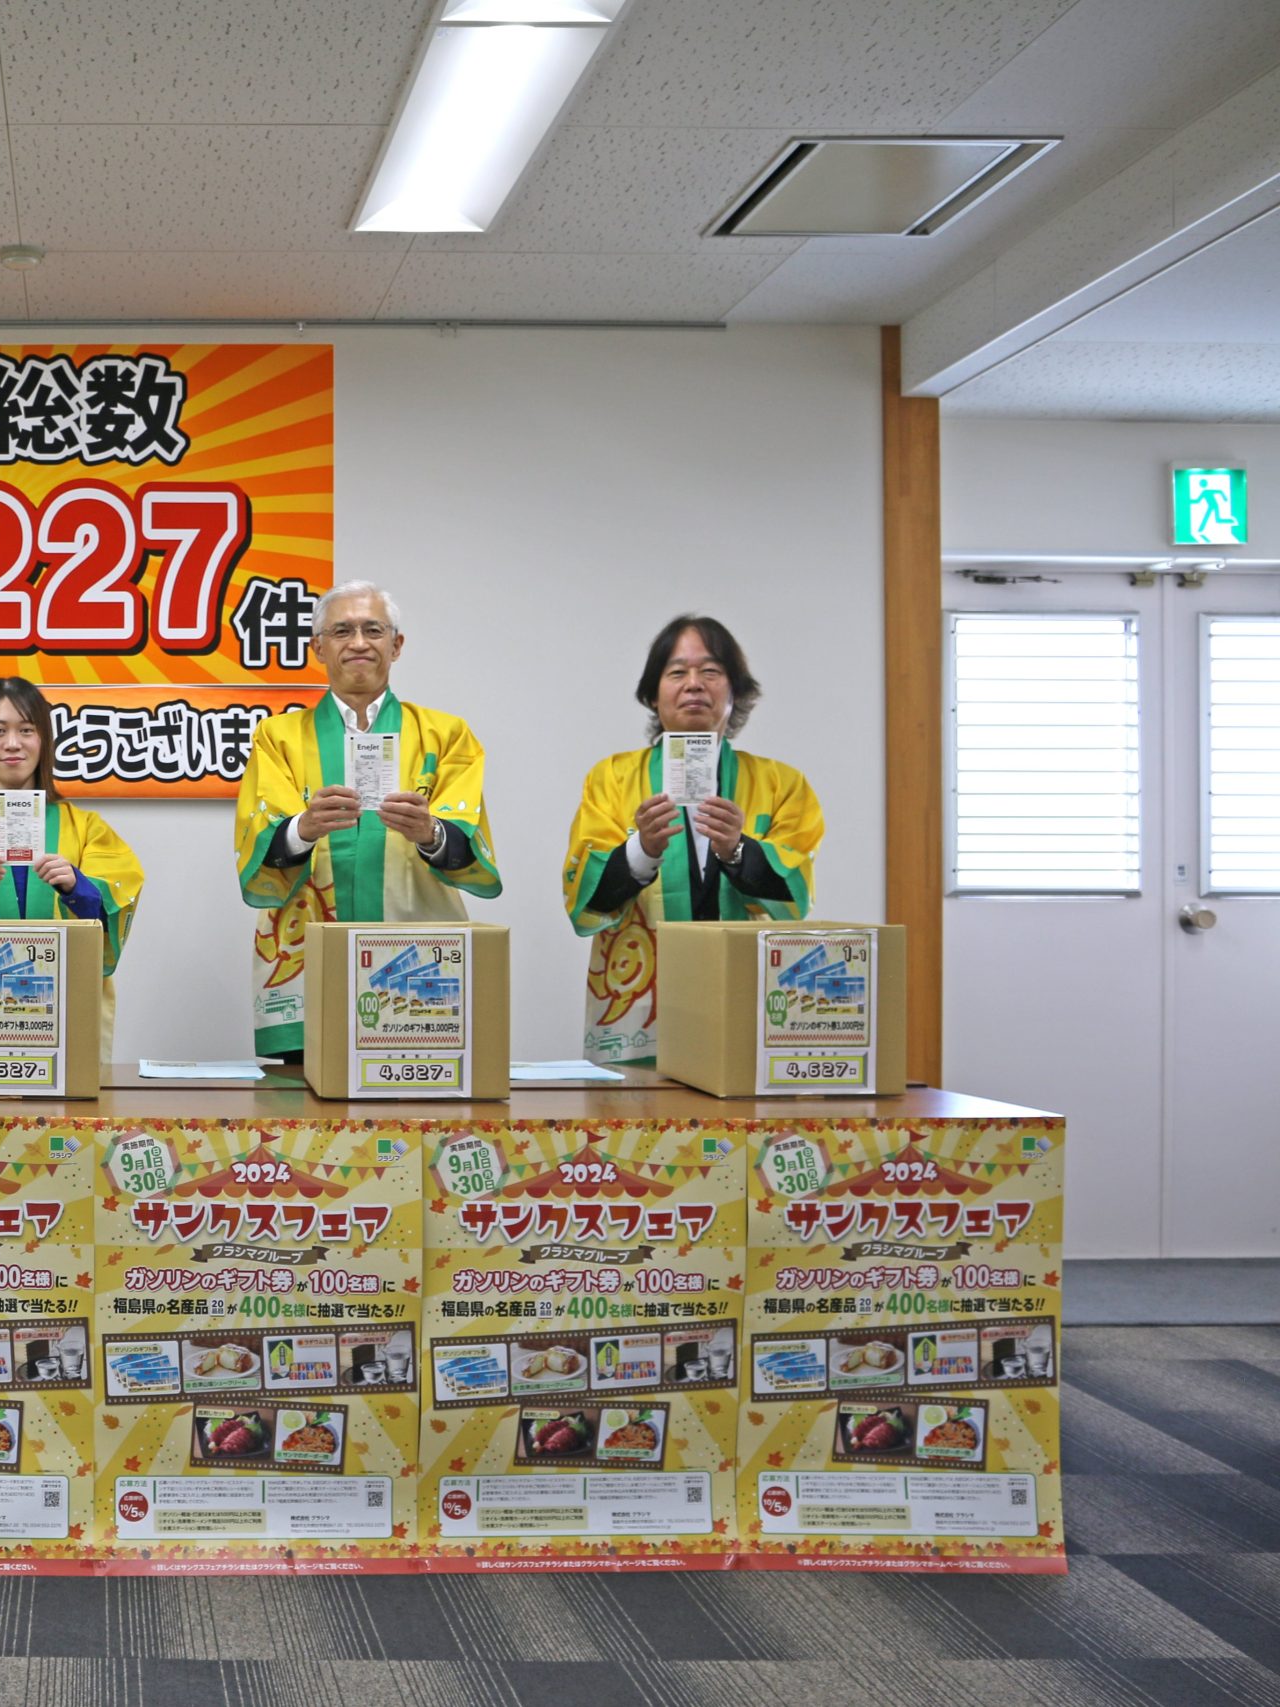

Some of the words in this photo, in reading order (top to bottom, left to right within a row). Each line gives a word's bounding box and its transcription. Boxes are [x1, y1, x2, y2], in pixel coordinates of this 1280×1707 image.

[27, 945, 55, 962] 1-3
[432, 947, 461, 963] 1-2
[843, 946, 866, 962] 1-1
[360, 998, 378, 1012] 100
[768, 996, 786, 1010] 100
[231, 1162, 291, 1183] 2024
[559, 1162, 617, 1184] 2024
[881, 1160, 938, 1182] 2024
[131, 1201, 392, 1242] サンクスフェア
[459, 1201, 717, 1242] サンクスフェア
[784, 1199, 1033, 1240] サンクスフェア
[213, 1246, 304, 1263] クラシマグループ
[541, 1246, 630, 1263] クラシマグループ
[862, 1244, 948, 1260] クラシマグループ
